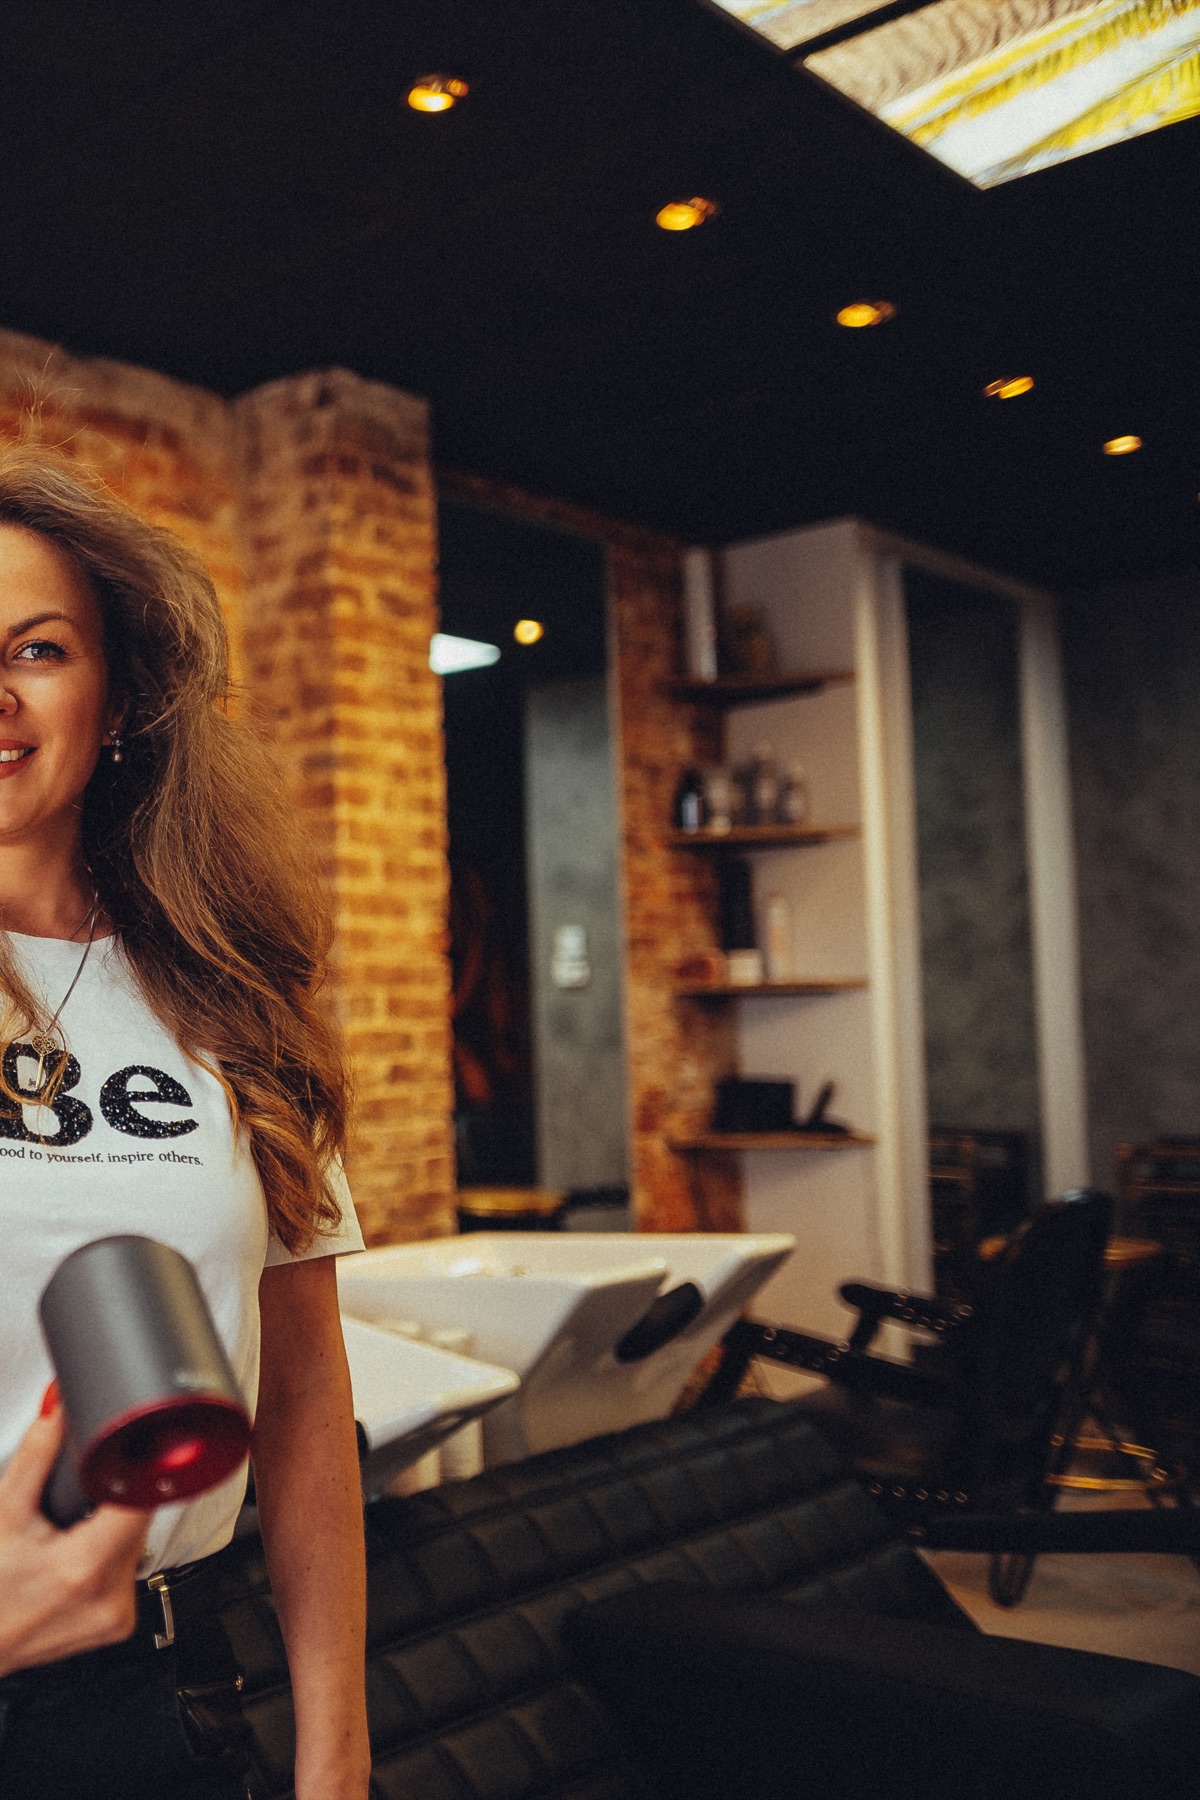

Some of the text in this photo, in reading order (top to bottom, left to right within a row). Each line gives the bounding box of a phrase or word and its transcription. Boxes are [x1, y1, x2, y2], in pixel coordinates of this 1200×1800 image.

[30, 1149, 42, 1160] to
[46, 1152, 104, 1164] yourself,
[107, 1151, 154, 1164] inspire
[158, 1151, 204, 1166] others.
